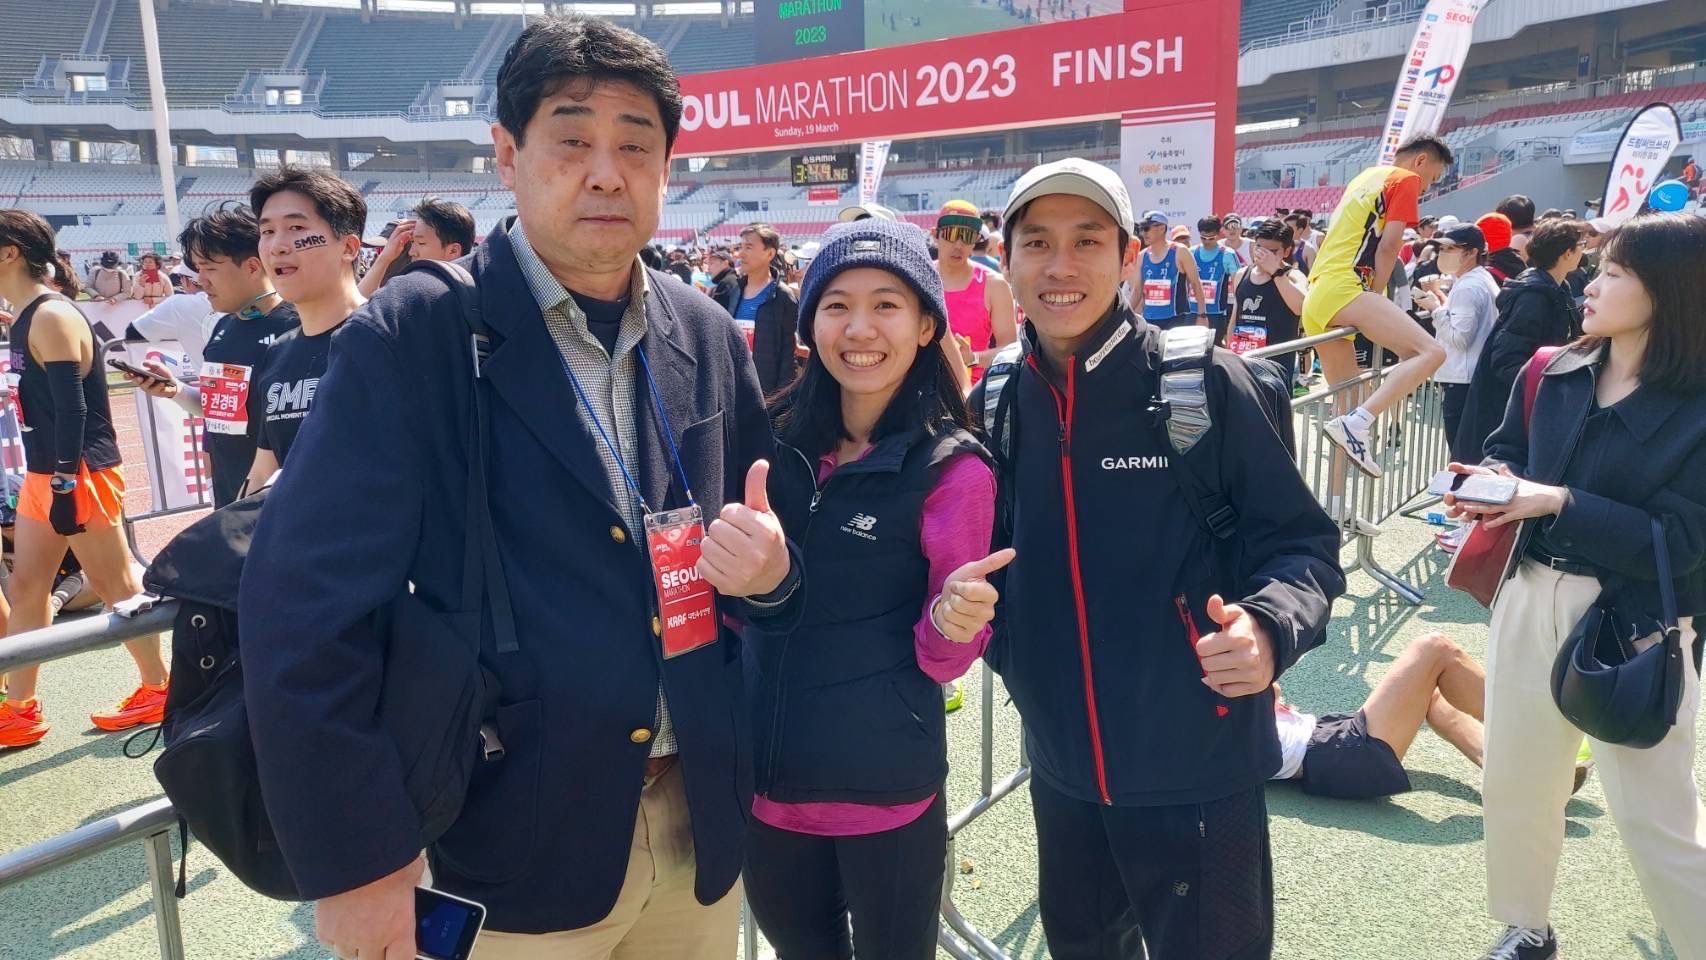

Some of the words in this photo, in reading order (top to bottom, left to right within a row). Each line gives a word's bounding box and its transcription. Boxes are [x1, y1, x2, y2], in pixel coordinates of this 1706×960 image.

[795, 25, 827, 45] 2023
[1053, 36, 1183, 87] FINISH
[756, 68, 908, 125] MARATHON
[915, 54, 1017, 107] 2023
[774, 126, 804, 137] Sunday,
[805, 125, 815, 135] 19
[816, 122, 839, 133] March
[294, 235, 326, 249] SMRC
[210, 392, 238, 411] 권경태
[852, 529, 877, 541] balance
[661, 565, 703, 589] SEOU
[663, 584, 691, 599] MARATHON
